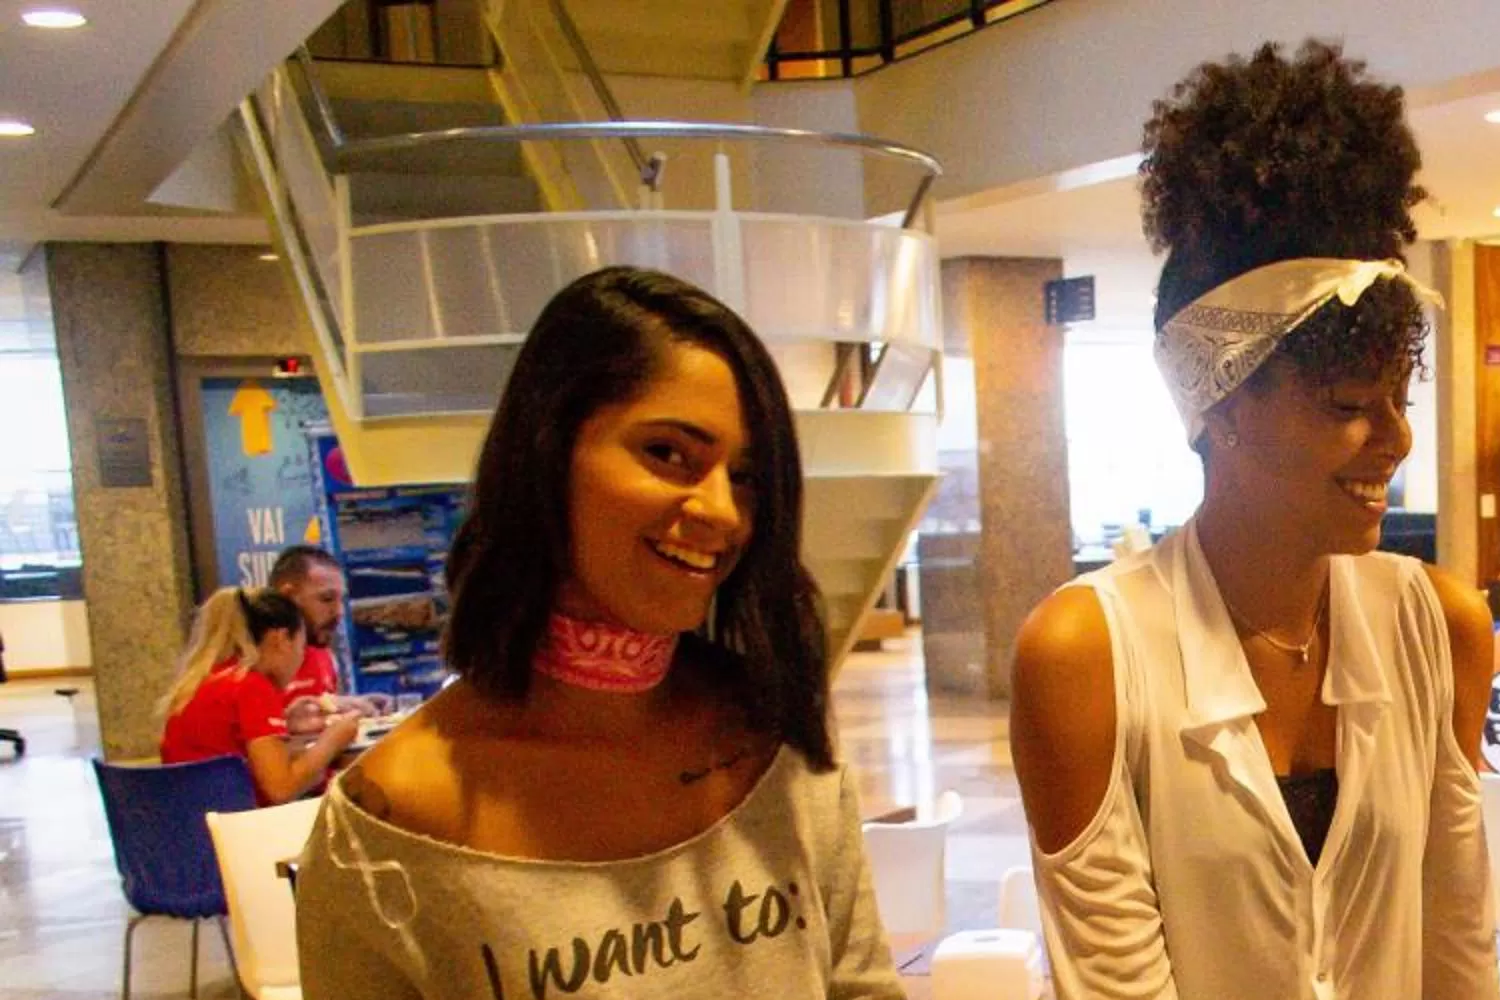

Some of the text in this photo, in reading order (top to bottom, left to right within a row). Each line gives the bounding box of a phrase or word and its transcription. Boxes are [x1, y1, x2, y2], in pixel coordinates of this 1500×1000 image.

[247, 506, 285, 545] VAI
[528, 897, 702, 1000] want
[722, 879, 808, 946] to:
